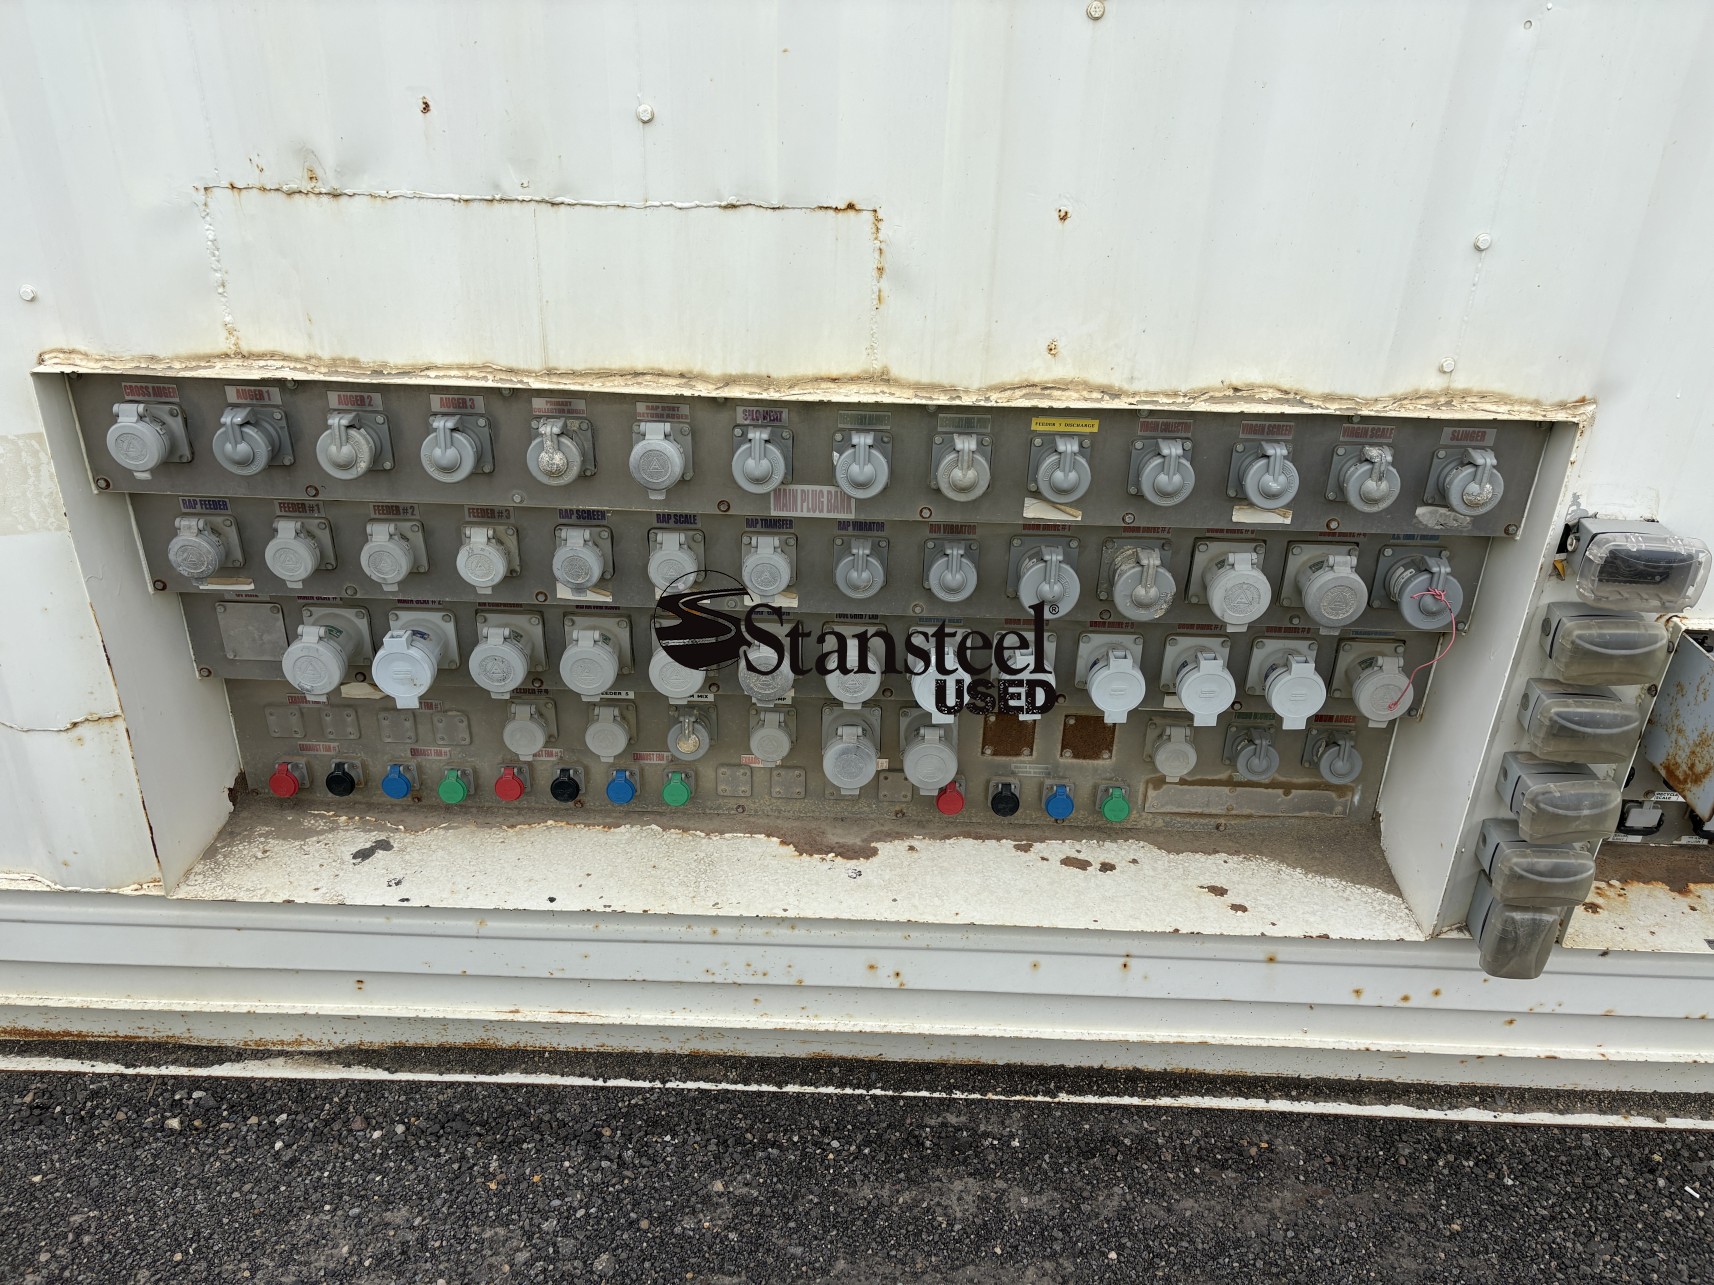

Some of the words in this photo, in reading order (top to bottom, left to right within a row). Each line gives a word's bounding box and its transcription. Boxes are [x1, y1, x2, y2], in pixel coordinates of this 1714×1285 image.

[123, 384, 150, 397] CROSS
[151, 386, 179, 399] AUGER
[235, 388, 264, 401] AUGER
[265, 390, 271, 401] 1
[337, 394, 366, 407] AUGER
[367, 396, 374, 407] 2
[439, 396, 468, 409] AUGER
[469, 398, 476, 410] 3
[533, 407, 566, 415] COLLECTOR
[1139, 421, 1160, 433] VIRGIN
[1241, 423, 1266, 435] VIRGIN
[1266, 424, 1293, 436] SCREEN
[1342, 426, 1370, 439] VIRGIN
[1370, 427, 1394, 440] SCALE
[1449, 429, 1487, 442] SLINGER
[181, 498, 198, 510] RAP
[199, 499, 229, 511] FEEDER
[278, 501, 307, 514] FEEDER
[773, 487, 798, 512] MAIN
[800, 489, 825, 514] PLUG
[827, 490, 852, 515] BANK
[372, 504, 400, 516] FEEDER
[467, 507, 495, 519] FEEDER
[558, 509, 574, 520] RAP
[575, 509, 606, 521] SCREEN
[656, 513, 672, 524] RAP
[673, 514, 697, 525] SCALE
[745, 518, 759, 529] RAP
[760, 518, 794, 530] TRANSFER
[837, 521, 851, 531] RAP
[852, 521, 885, 532] VIBRATOR
[942, 524, 977, 535] VIBRATOR
